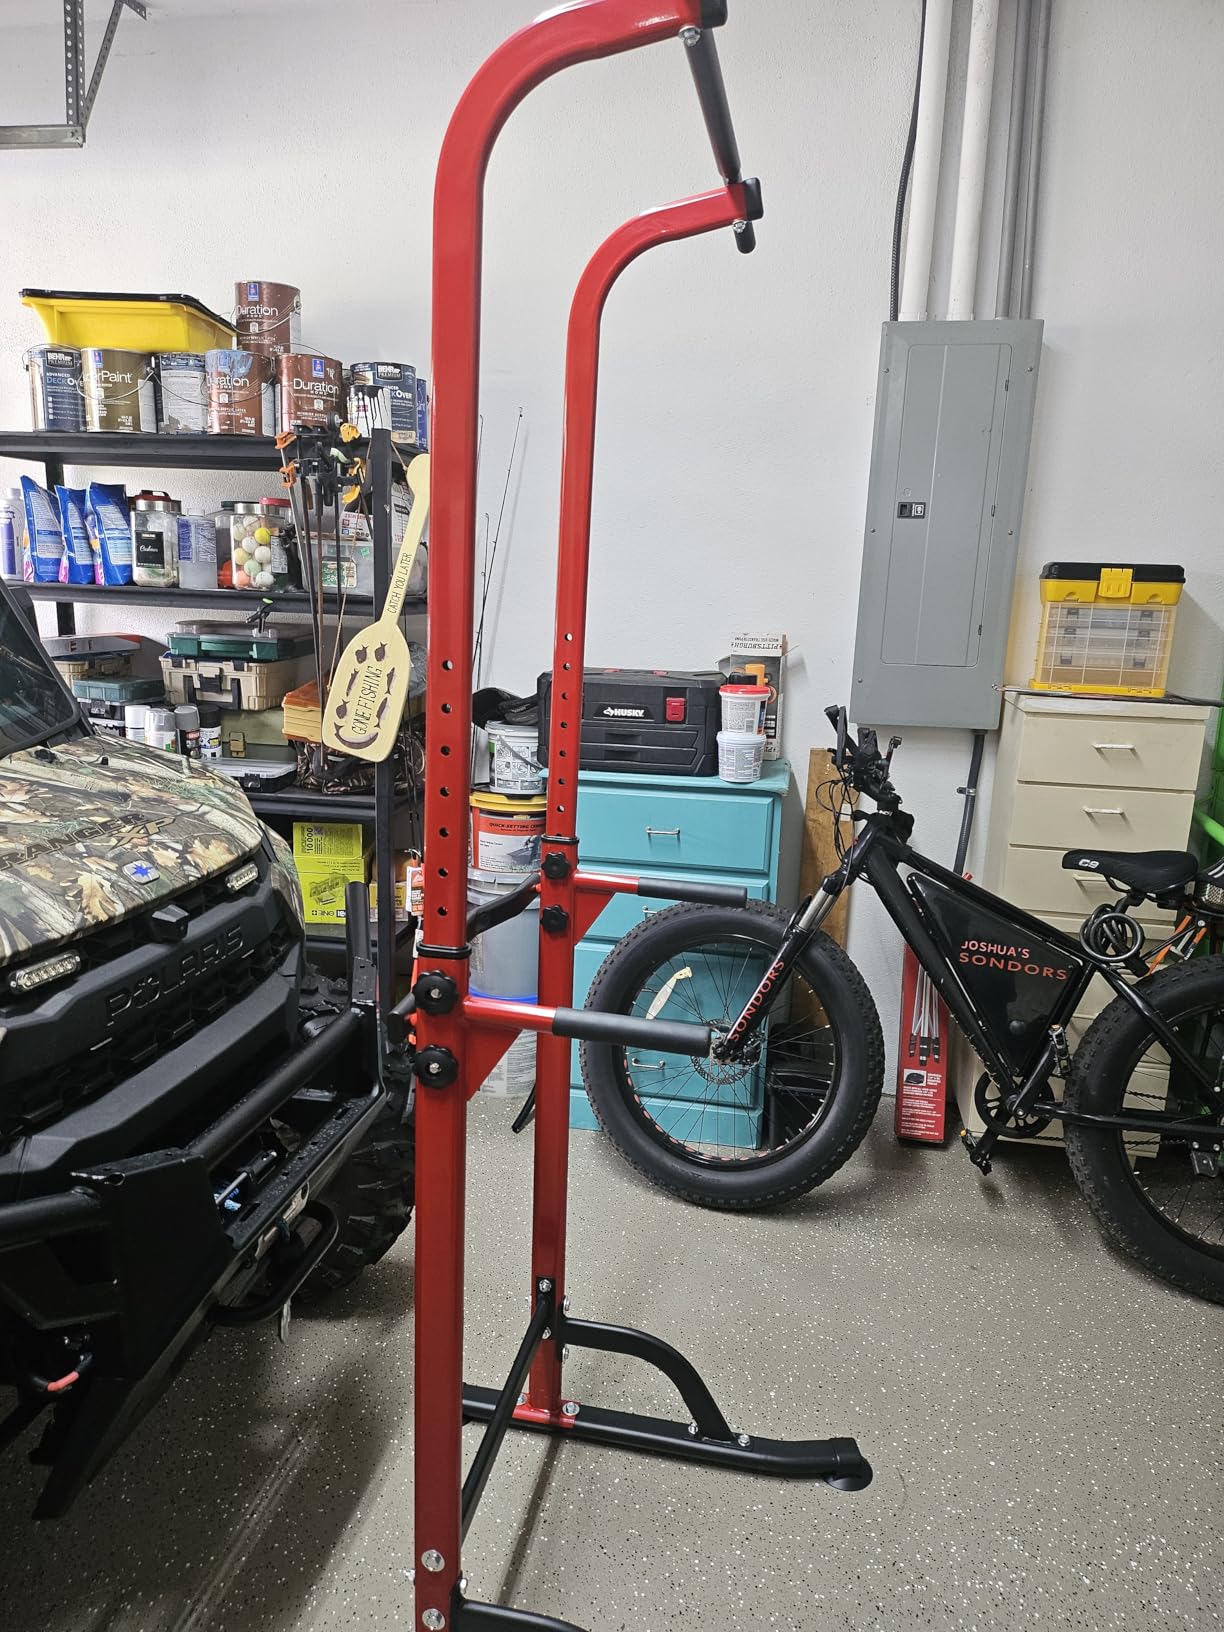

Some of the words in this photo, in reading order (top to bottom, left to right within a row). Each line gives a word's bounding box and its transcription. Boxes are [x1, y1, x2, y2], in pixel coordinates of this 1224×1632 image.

[236, 304, 279, 316] Duration
[293, 378, 339, 394] Duration
[387, 591, 401, 614] CATCH
[394, 576, 406, 591] YOU
[400, 552, 413, 576] LATER
[734, 642, 779, 650] PITTSBURGH
[357, 666, 383, 710] FISHING
[352, 709, 372, 735] GONE
[614, 708, 645, 717] HUSKY
[0, 813, 147, 872] RANGER
[109, 816, 176, 850] XP
[961, 940, 1030, 959] JOSHUA'S
[106, 926, 244, 1026] POLARIS
[959, 952, 1067, 980] SONDORS
[730, 961, 785, 1041] SONDORS
